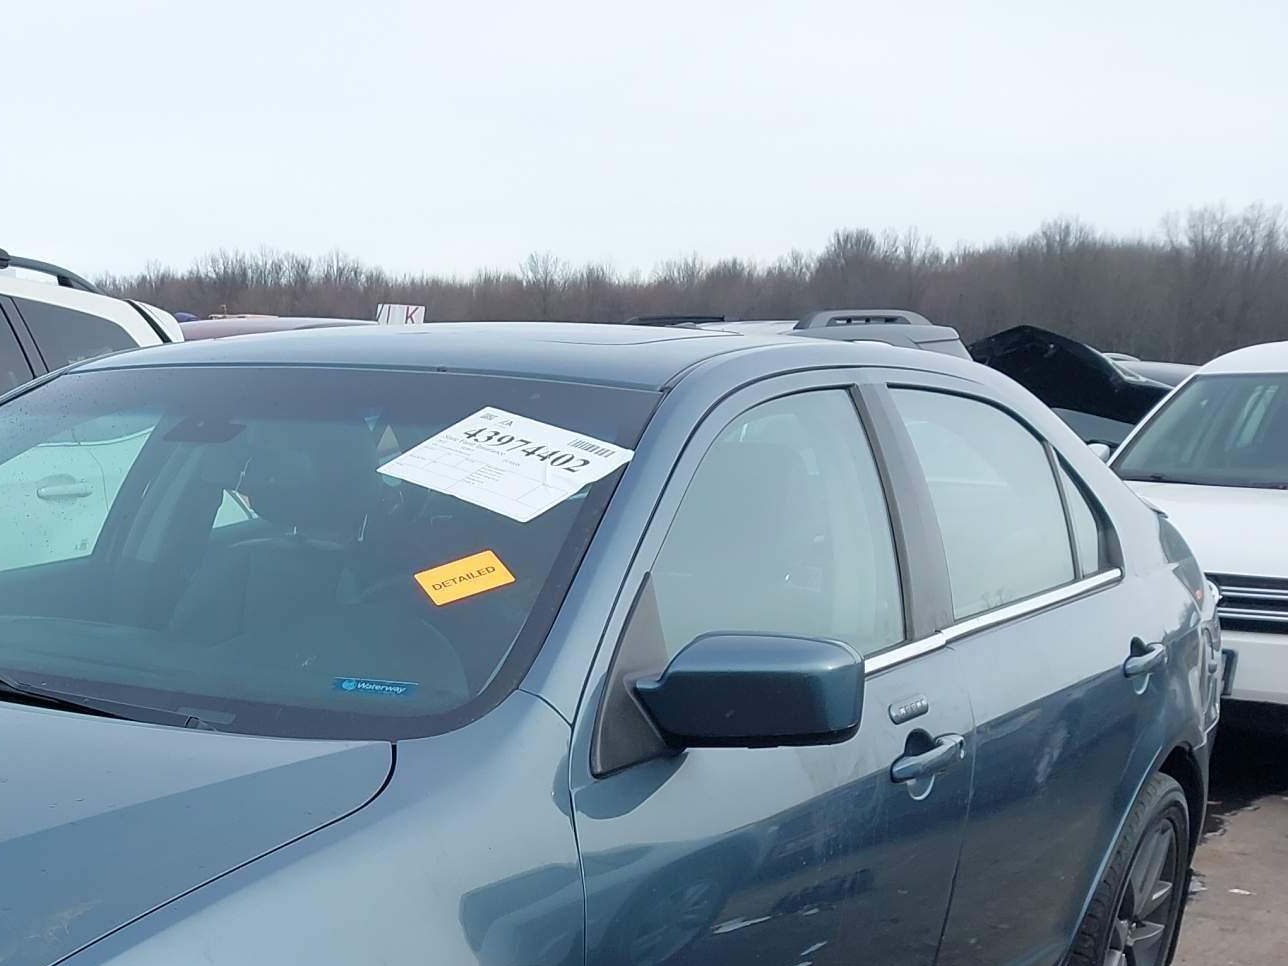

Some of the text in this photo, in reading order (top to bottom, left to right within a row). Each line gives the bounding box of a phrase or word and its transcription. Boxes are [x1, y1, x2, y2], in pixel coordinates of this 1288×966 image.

[464, 427, 590, 473] 43974402
[432, 566, 496, 591] DETAILED
[357, 681, 406, 694] Waterway
